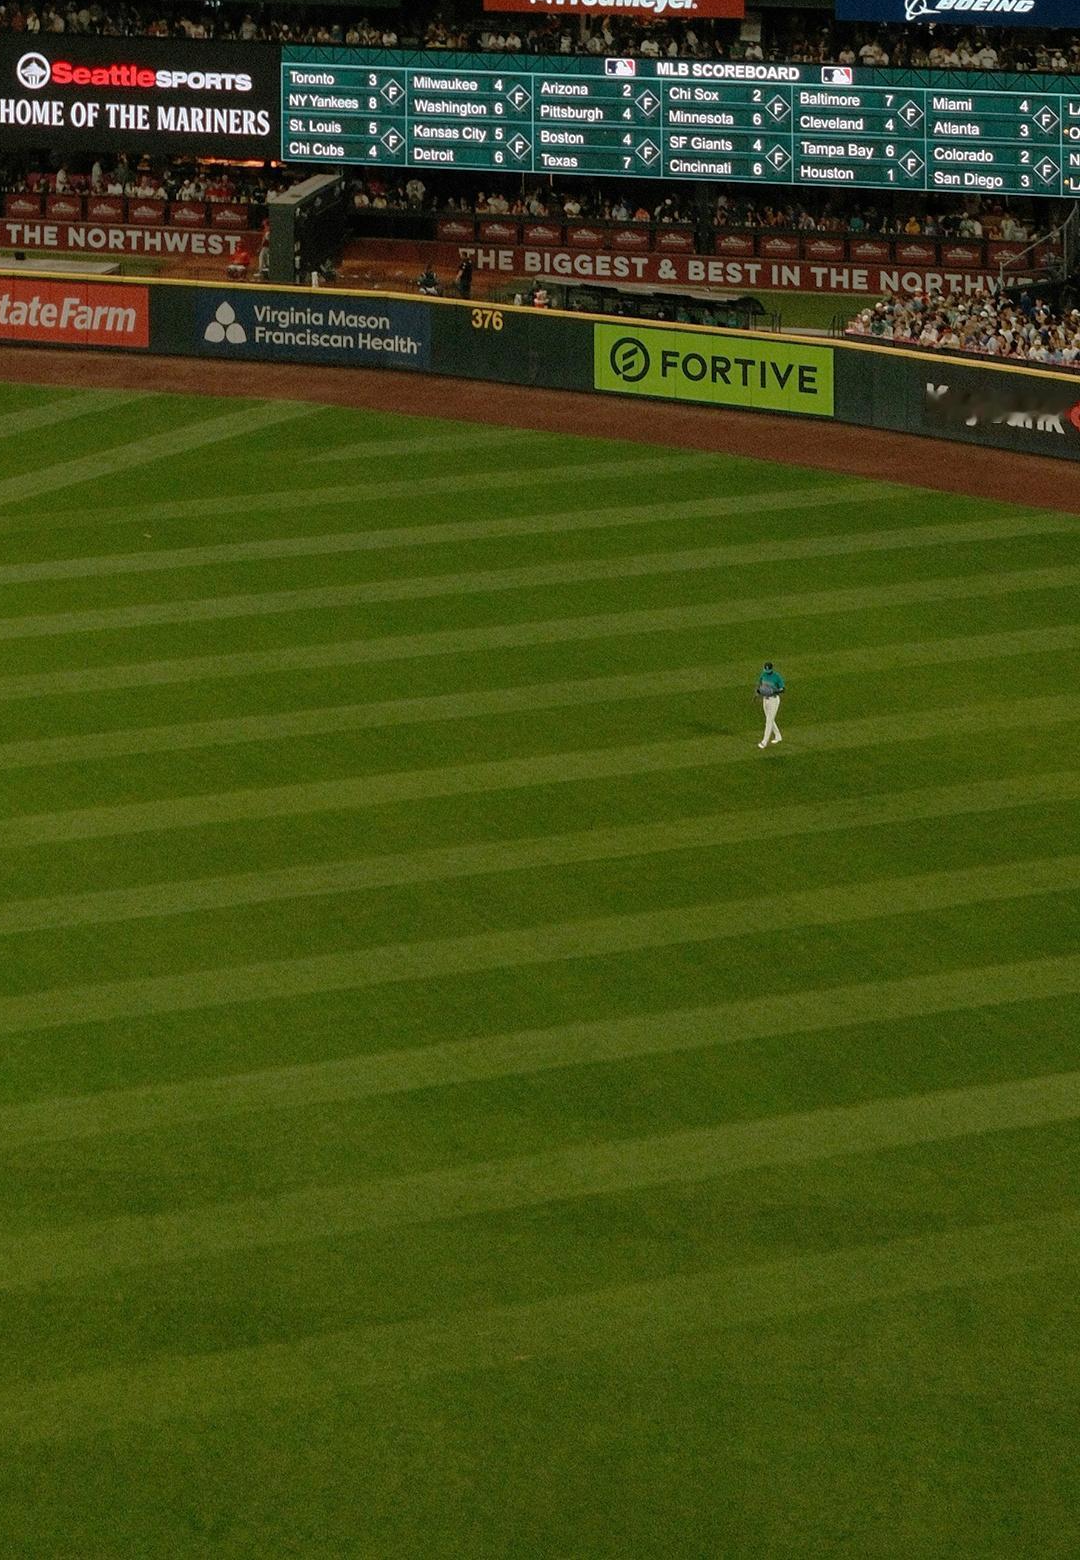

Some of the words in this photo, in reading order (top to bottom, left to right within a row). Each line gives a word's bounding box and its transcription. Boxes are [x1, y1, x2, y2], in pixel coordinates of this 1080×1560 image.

[289, 70, 335, 85] Toronto
[368, 73, 378, 87] 3
[656, 61, 690, 76] MLB
[691, 63, 800, 81] SCOREBOARD
[413, 75, 478, 91] Milwaukee
[494, 79, 503, 92] 4
[540, 81, 589, 96] Arizona
[622, 83, 632, 97] 2
[289, 93, 308, 107] NY
[309, 94, 359, 110] Yankees
[368, 96, 378, 110] 8
[388, 87, 398, 100] F
[514, 91, 524, 105] F
[669, 86, 692, 100] Chi
[694, 87, 720, 101] Sox
[752, 89, 762, 102] 2
[799, 91, 861, 107] Baltimore
[885, 94, 894, 107] 7
[414, 99, 487, 117] Washington
[494, 102, 504, 115] 6
[643, 97, 653, 110] F
[773, 102, 784, 115] F
[932, 97, 972, 111] Miami
[1019, 100, 1029, 113] 4
[71, 102, 99, 128] OF
[102, 103, 150, 130] THE
[154, 107, 271, 137] MARINERS
[540, 104, 604, 123] Pittsburgh
[622, 107, 632, 120] 4
[669, 109, 734, 125] Minnesota
[752, 112, 762, 126] 6
[906, 108, 916, 121] F
[1041, 113, 1051, 127] F
[289, 118, 306, 132] St.
[309, 119, 342, 134] Louis
[368, 121, 378, 135] 5
[800, 115, 864, 131] Cleveland
[884, 118, 894, 131] 4
[933, 121, 980, 136] Atlanta
[1020, 124, 1029, 137] 3
[388, 135, 398, 148] F
[413, 124, 460, 139] Kansas
[462, 126, 487, 143] City
[494, 127, 504, 140] 5
[540, 130, 584, 144] Boston
[622, 133, 632, 146] 4
[289, 141, 310, 155] Chi
[312, 142, 345, 157] Cubs
[368, 144, 378, 158] 4
[514, 140, 524, 153] F
[669, 135, 688, 149] SF
[690, 136, 733, 151] Giants
[752, 138, 762, 152] 4
[800, 141, 845, 158] Tampa
[848, 143, 874, 160] Bay
[885, 144, 895, 157] 6
[413, 147, 454, 162] Detroit
[494, 150, 504, 164] 6
[541, 153, 578, 168] Texas
[623, 156, 632, 169] 7
[643, 146, 653, 159] F
[774, 152, 784, 165] F
[933, 147, 994, 162] Colorado
[1020, 150, 1030, 164] 2
[669, 159, 732, 174] Cincinnati
[753, 162, 763, 176] 6
[907, 158, 917, 171] F
[1042, 164, 1052, 177] F
[800, 165, 854, 180] Houston
[887, 168, 894, 182] 1
[934, 171, 961, 185] San
[964, 172, 1004, 190] Diego
[1020, 174, 1030, 188] 3
[5, 223, 59, 247] THE
[68, 226, 241, 255] NORTHWEST
[524, 251, 649, 279] BIGGEST
[657, 256, 678, 281] &
[687, 260, 762, 286] BEST
[772, 265, 803, 287] IN
[810, 266, 870, 291] THE
[253, 304, 323, 326] Virginia
[327, 309, 391, 330] Mason
[472, 309, 503, 330] 376
[254, 326, 353, 349] Franciscan
[357, 334, 418, 355] Health
[661, 350, 818, 394] FORTIVE
